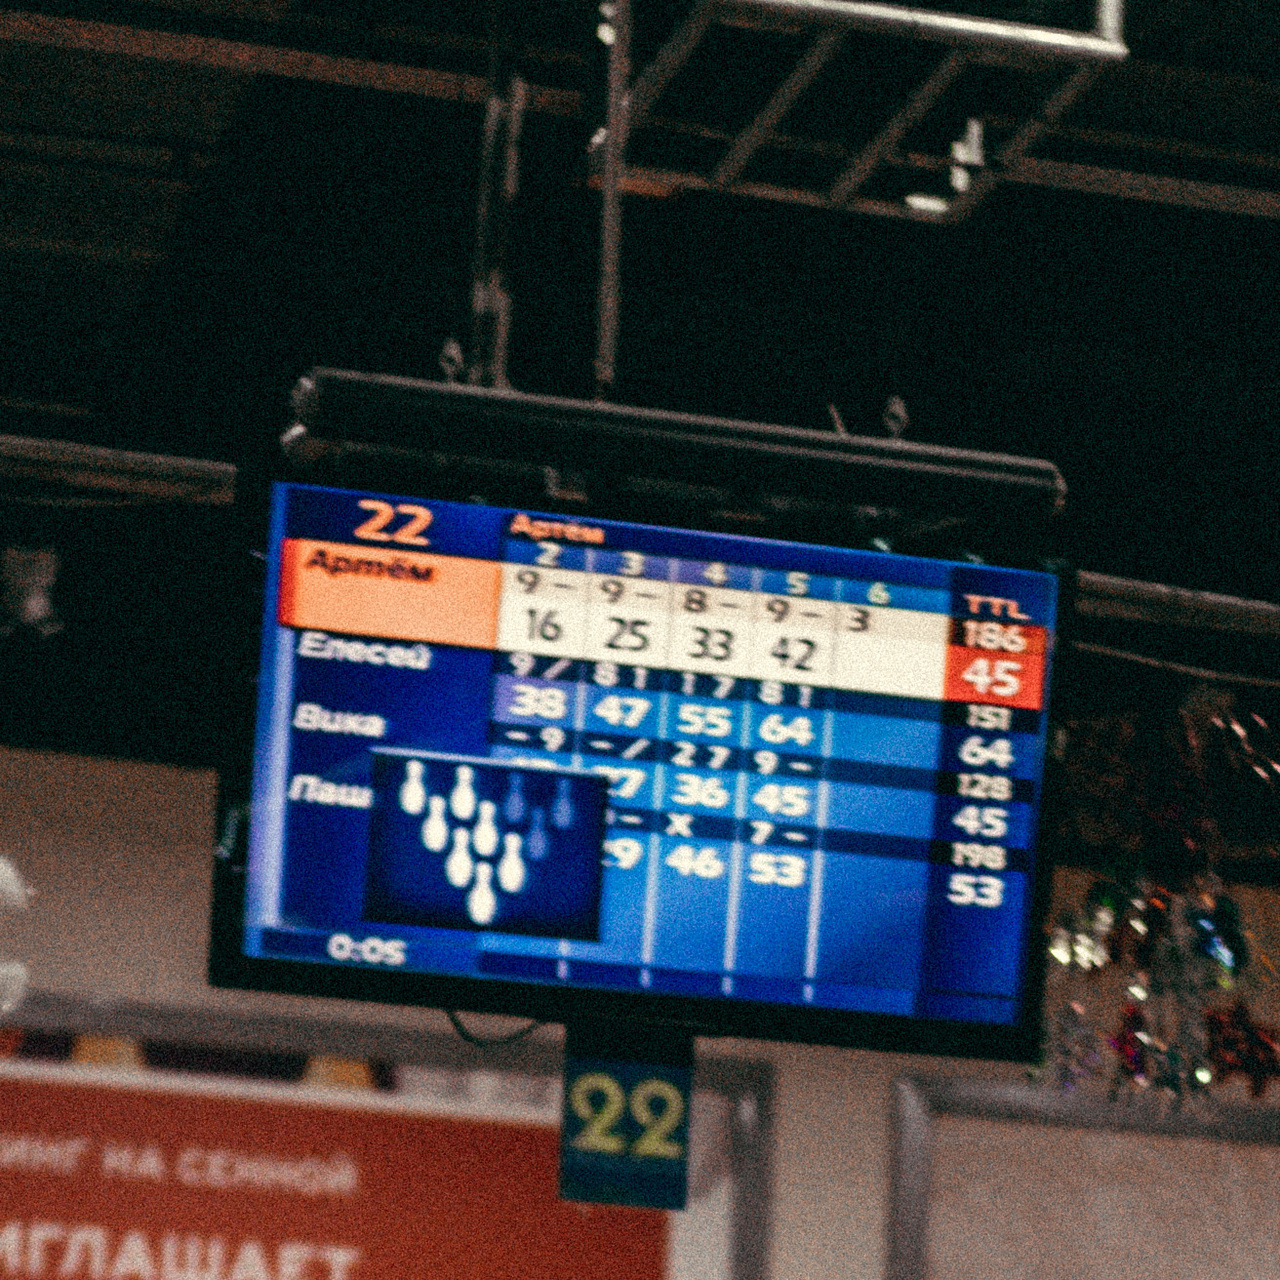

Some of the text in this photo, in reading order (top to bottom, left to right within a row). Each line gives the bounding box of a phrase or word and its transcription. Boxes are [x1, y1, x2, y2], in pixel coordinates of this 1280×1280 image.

[353, 499, 434, 547] 22
[303, 548, 436, 583] Артём
[534, 540, 891, 608] 2 3 4 5 6
[962, 593, 1032, 621] TTL
[963, 619, 1028, 653] 186
[526, 607, 1023, 697] 16 25 33 42 45
[507, 682, 1016, 769] 38 47 55 64 64
[671, 773, 731, 809] 36
[751, 782, 811, 818] 45
[952, 805, 1009, 838] 45
[664, 844, 726, 879] 46
[747, 851, 807, 888] 53
[946, 872, 1005, 908] 53
[327, 933, 408, 966] 0:05
[568, 1072, 684, 1159] 22
[102, 1143, 163, 1182] НА
[176, 1147, 359, 1197] СЕННОЙ
